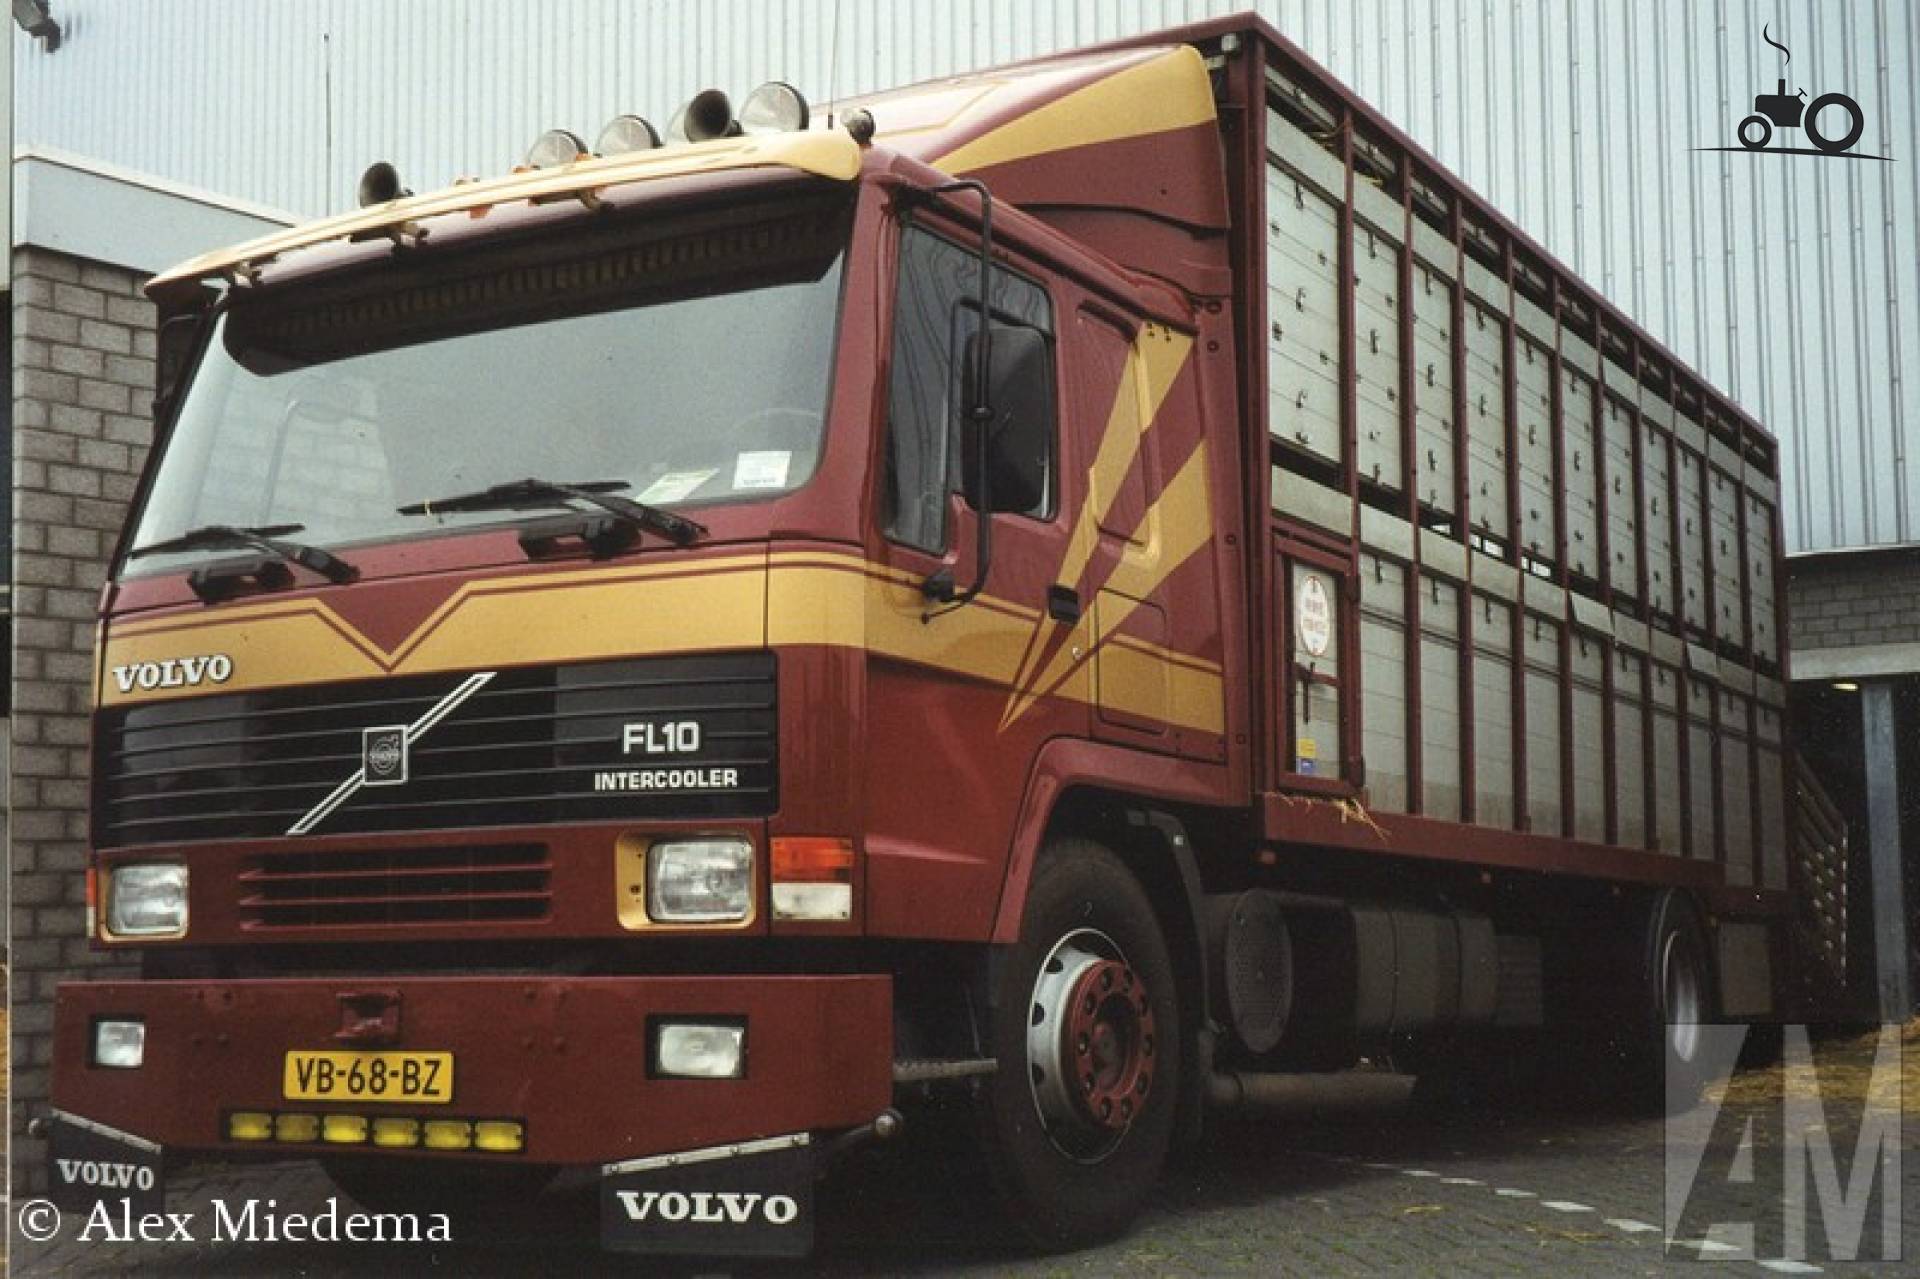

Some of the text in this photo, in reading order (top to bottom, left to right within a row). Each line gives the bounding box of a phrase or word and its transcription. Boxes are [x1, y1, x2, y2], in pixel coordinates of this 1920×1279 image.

[112, 654, 233, 694] VOLVO
[622, 721, 701, 755] FL10
[593, 768, 739, 792] INTERCOOLER
[295, 1056, 442, 1096] VB-68-BZ
[57, 1158, 156, 1191] VOLVO
[616, 1189, 799, 1225] VOLVO
